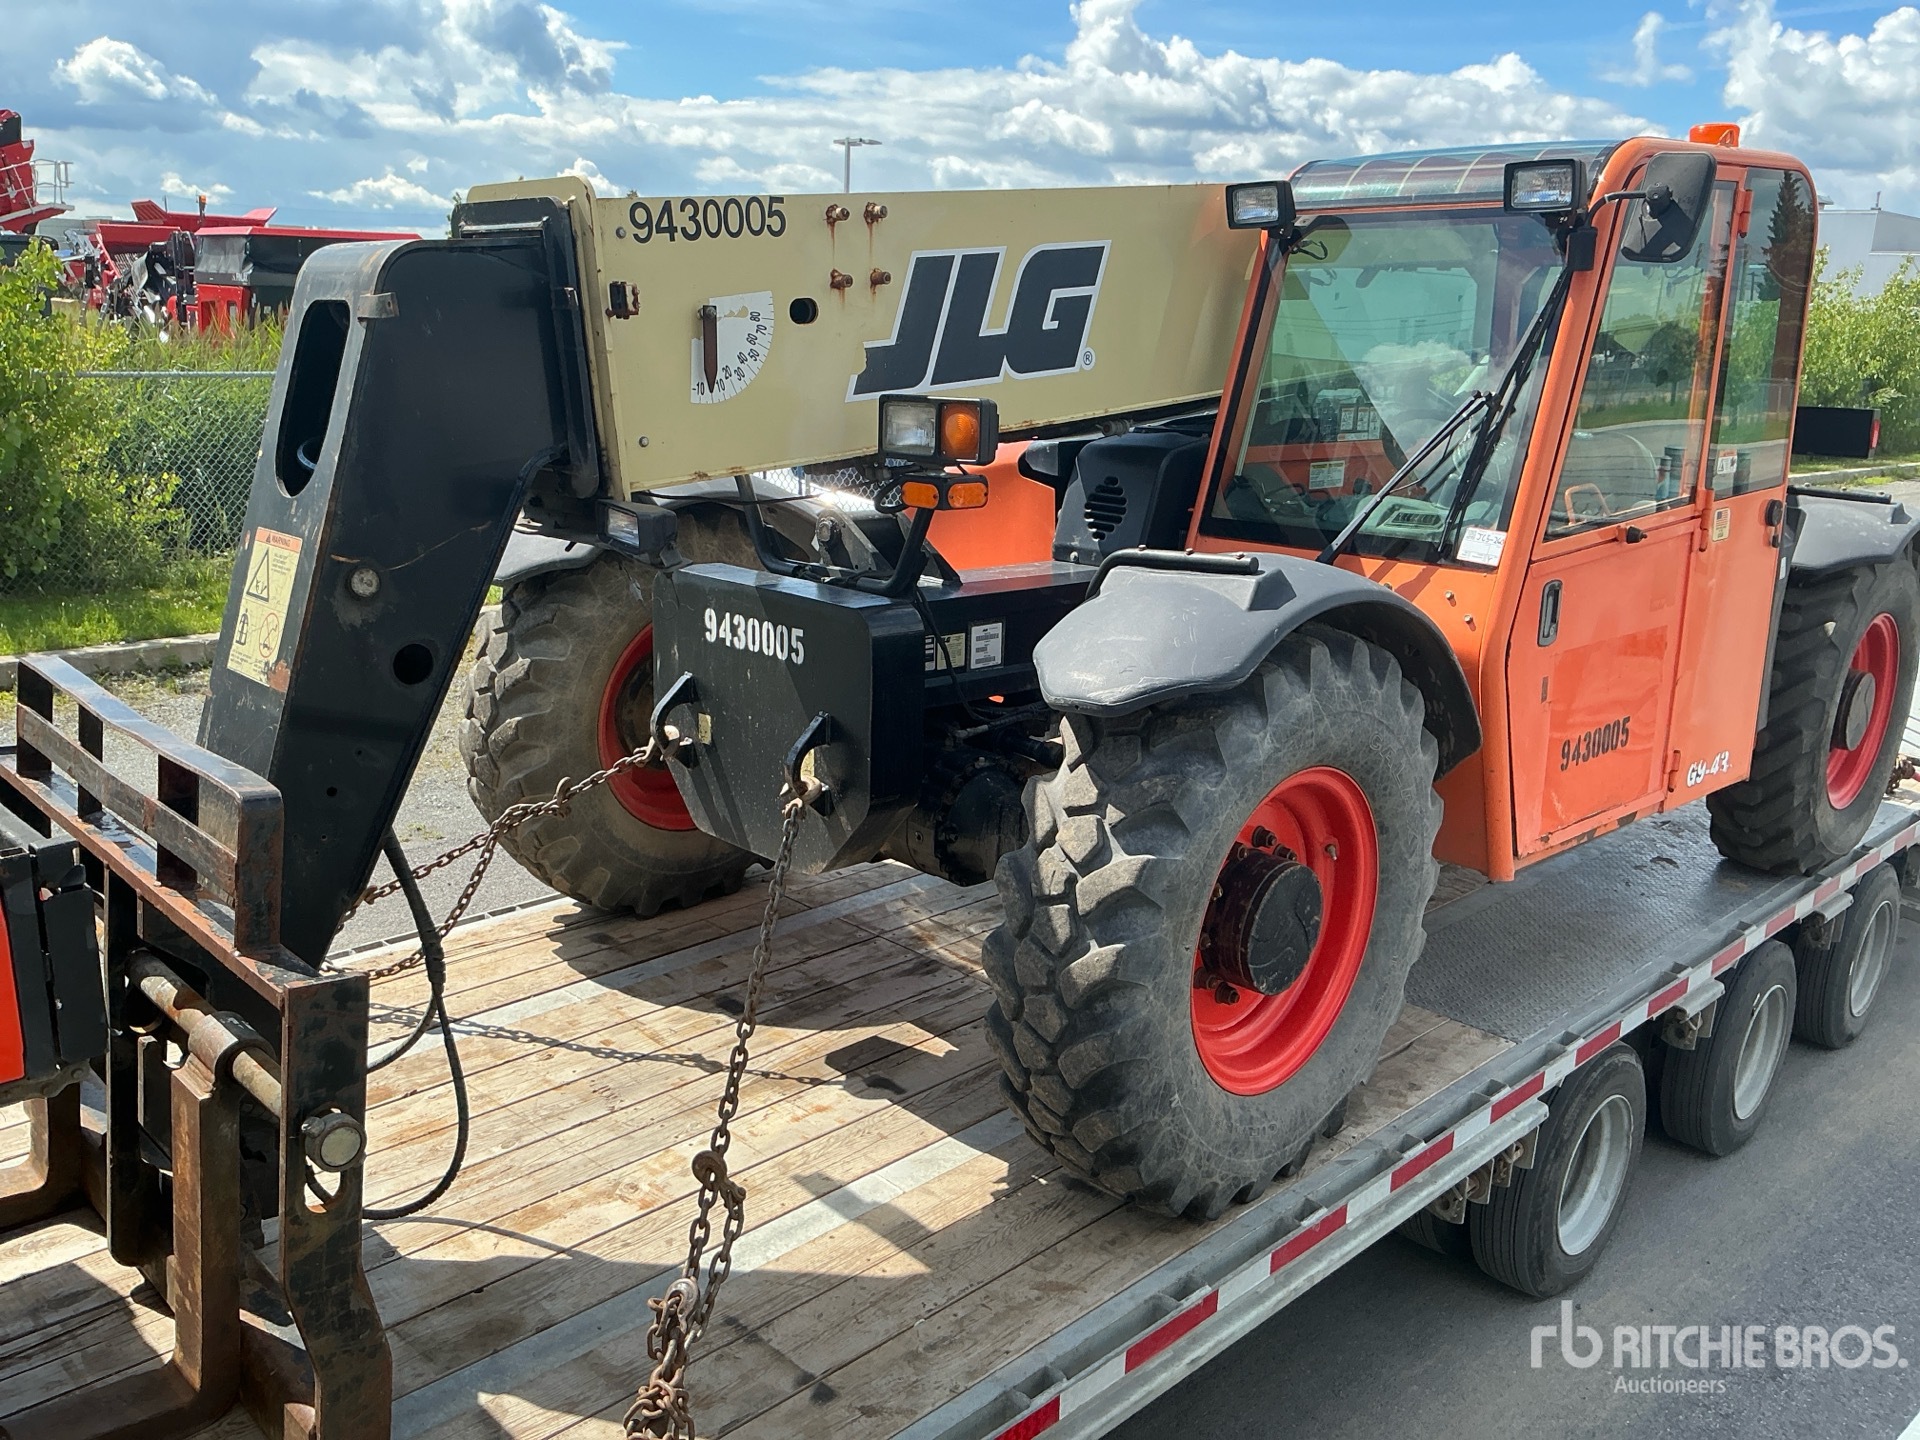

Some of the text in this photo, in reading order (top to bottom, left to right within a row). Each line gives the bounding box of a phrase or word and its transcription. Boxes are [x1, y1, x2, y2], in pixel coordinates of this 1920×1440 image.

[629, 196, 787, 244] 9430005
[750, 311, 761, 322] 80
[846, 239, 1112, 403] JLG
[756, 324, 767, 336] 70
[746, 333, 758, 346] 60
[737, 351, 748, 365] 40
[747, 348, 760, 362] 50
[722, 364, 732, 380] 20
[733, 366, 746, 381] 30
[716, 378, 726, 393] 10
[704, 608, 804, 665] 9430005
[1560, 716, 1631, 772] 9430005
